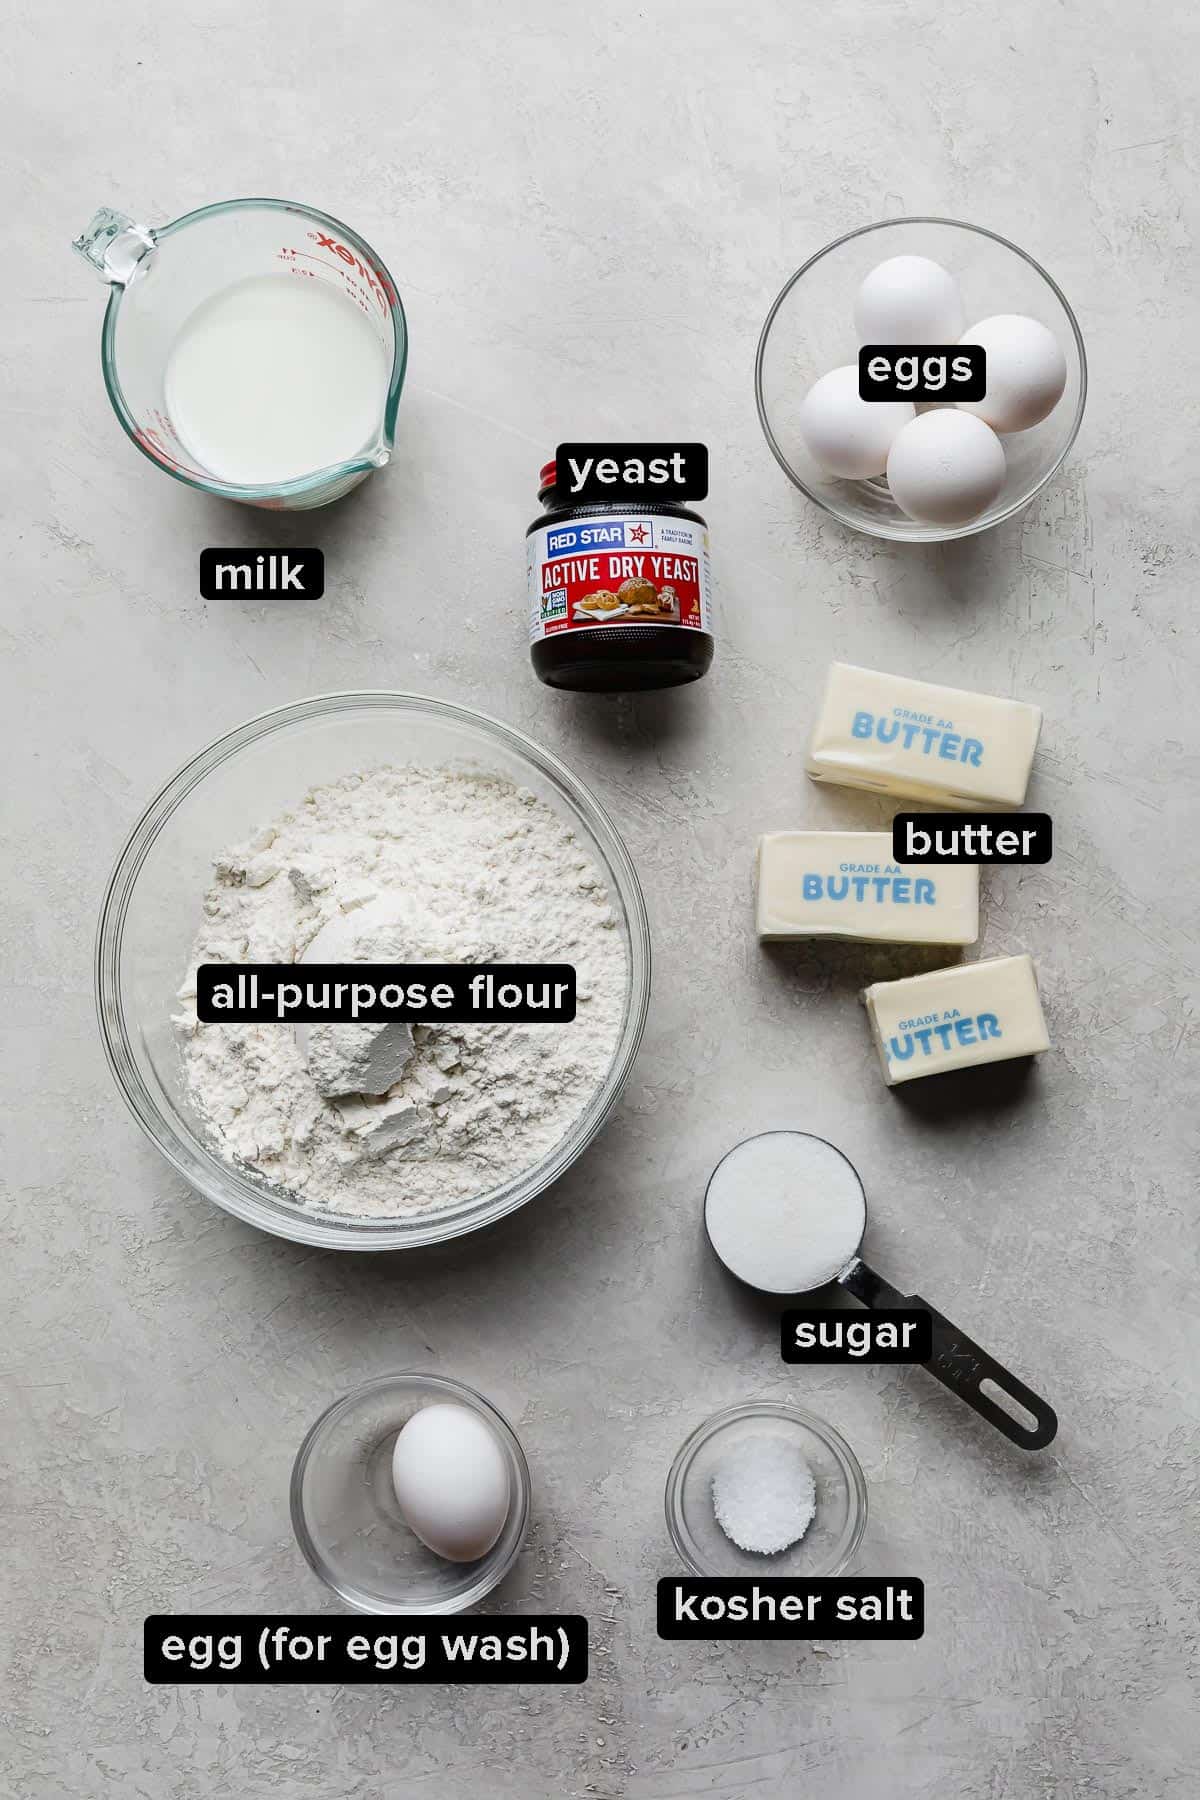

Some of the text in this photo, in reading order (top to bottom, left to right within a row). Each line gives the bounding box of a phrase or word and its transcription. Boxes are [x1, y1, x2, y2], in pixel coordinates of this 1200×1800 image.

[549, 527, 622, 551] RED STAR
[543, 555, 698, 590] ACTIVE DRY YEAST
[893, 707, 954, 730] GRADE AA
[851, 711, 984, 768] BUTTER
[839, 863, 901, 874] GRADE AA
[802, 873, 936, 905] BUTTER
[898, 1008, 961, 1031] GRADE AA
